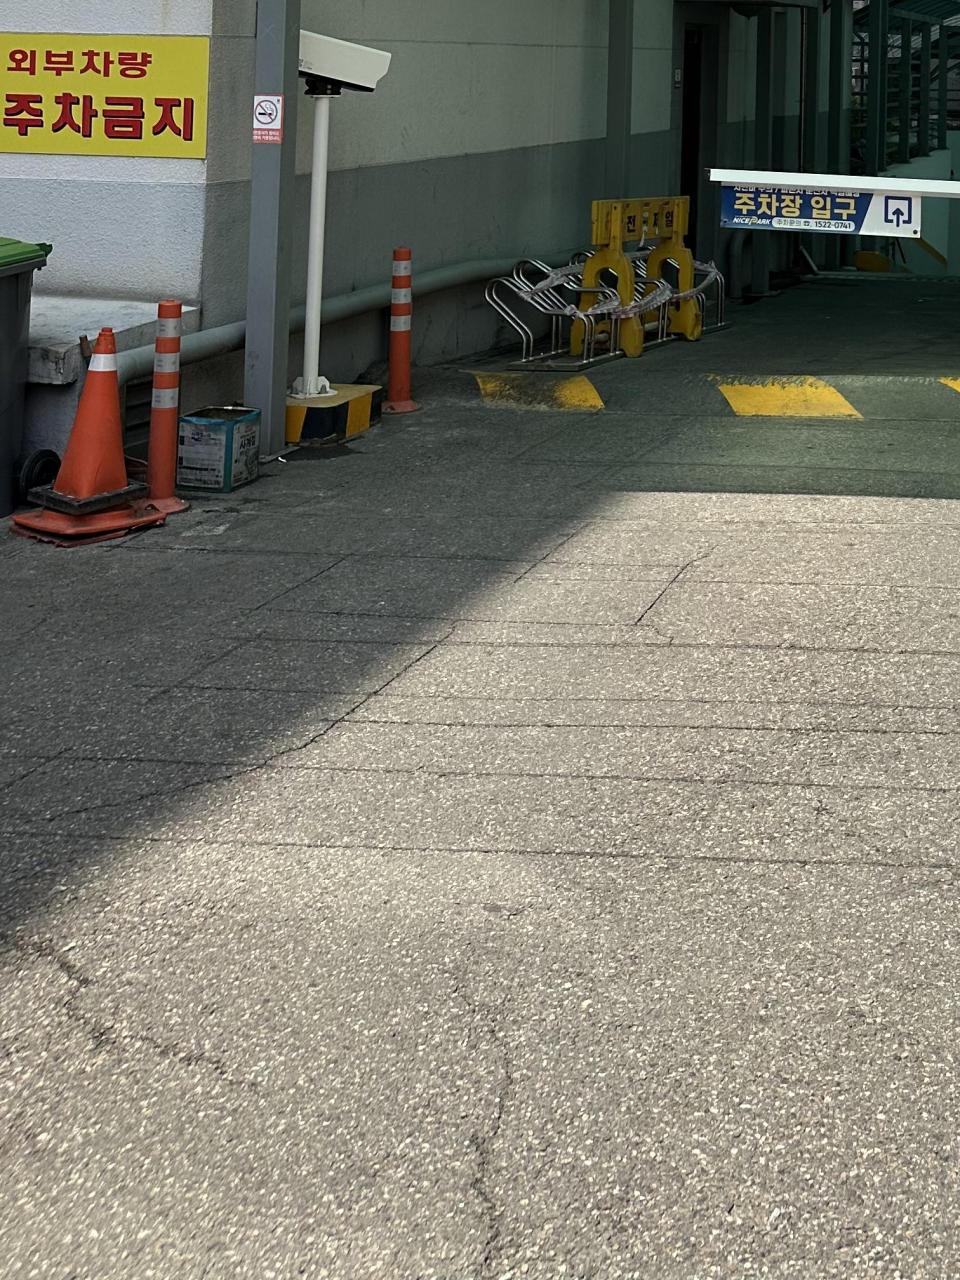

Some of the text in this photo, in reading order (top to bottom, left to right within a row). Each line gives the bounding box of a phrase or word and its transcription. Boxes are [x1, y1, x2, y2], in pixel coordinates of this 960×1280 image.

[6, 48, 153, 79] 외부차량
[3, 92, 195, 141] 주차금지
[733, 192, 857, 220] 주차장 입구
